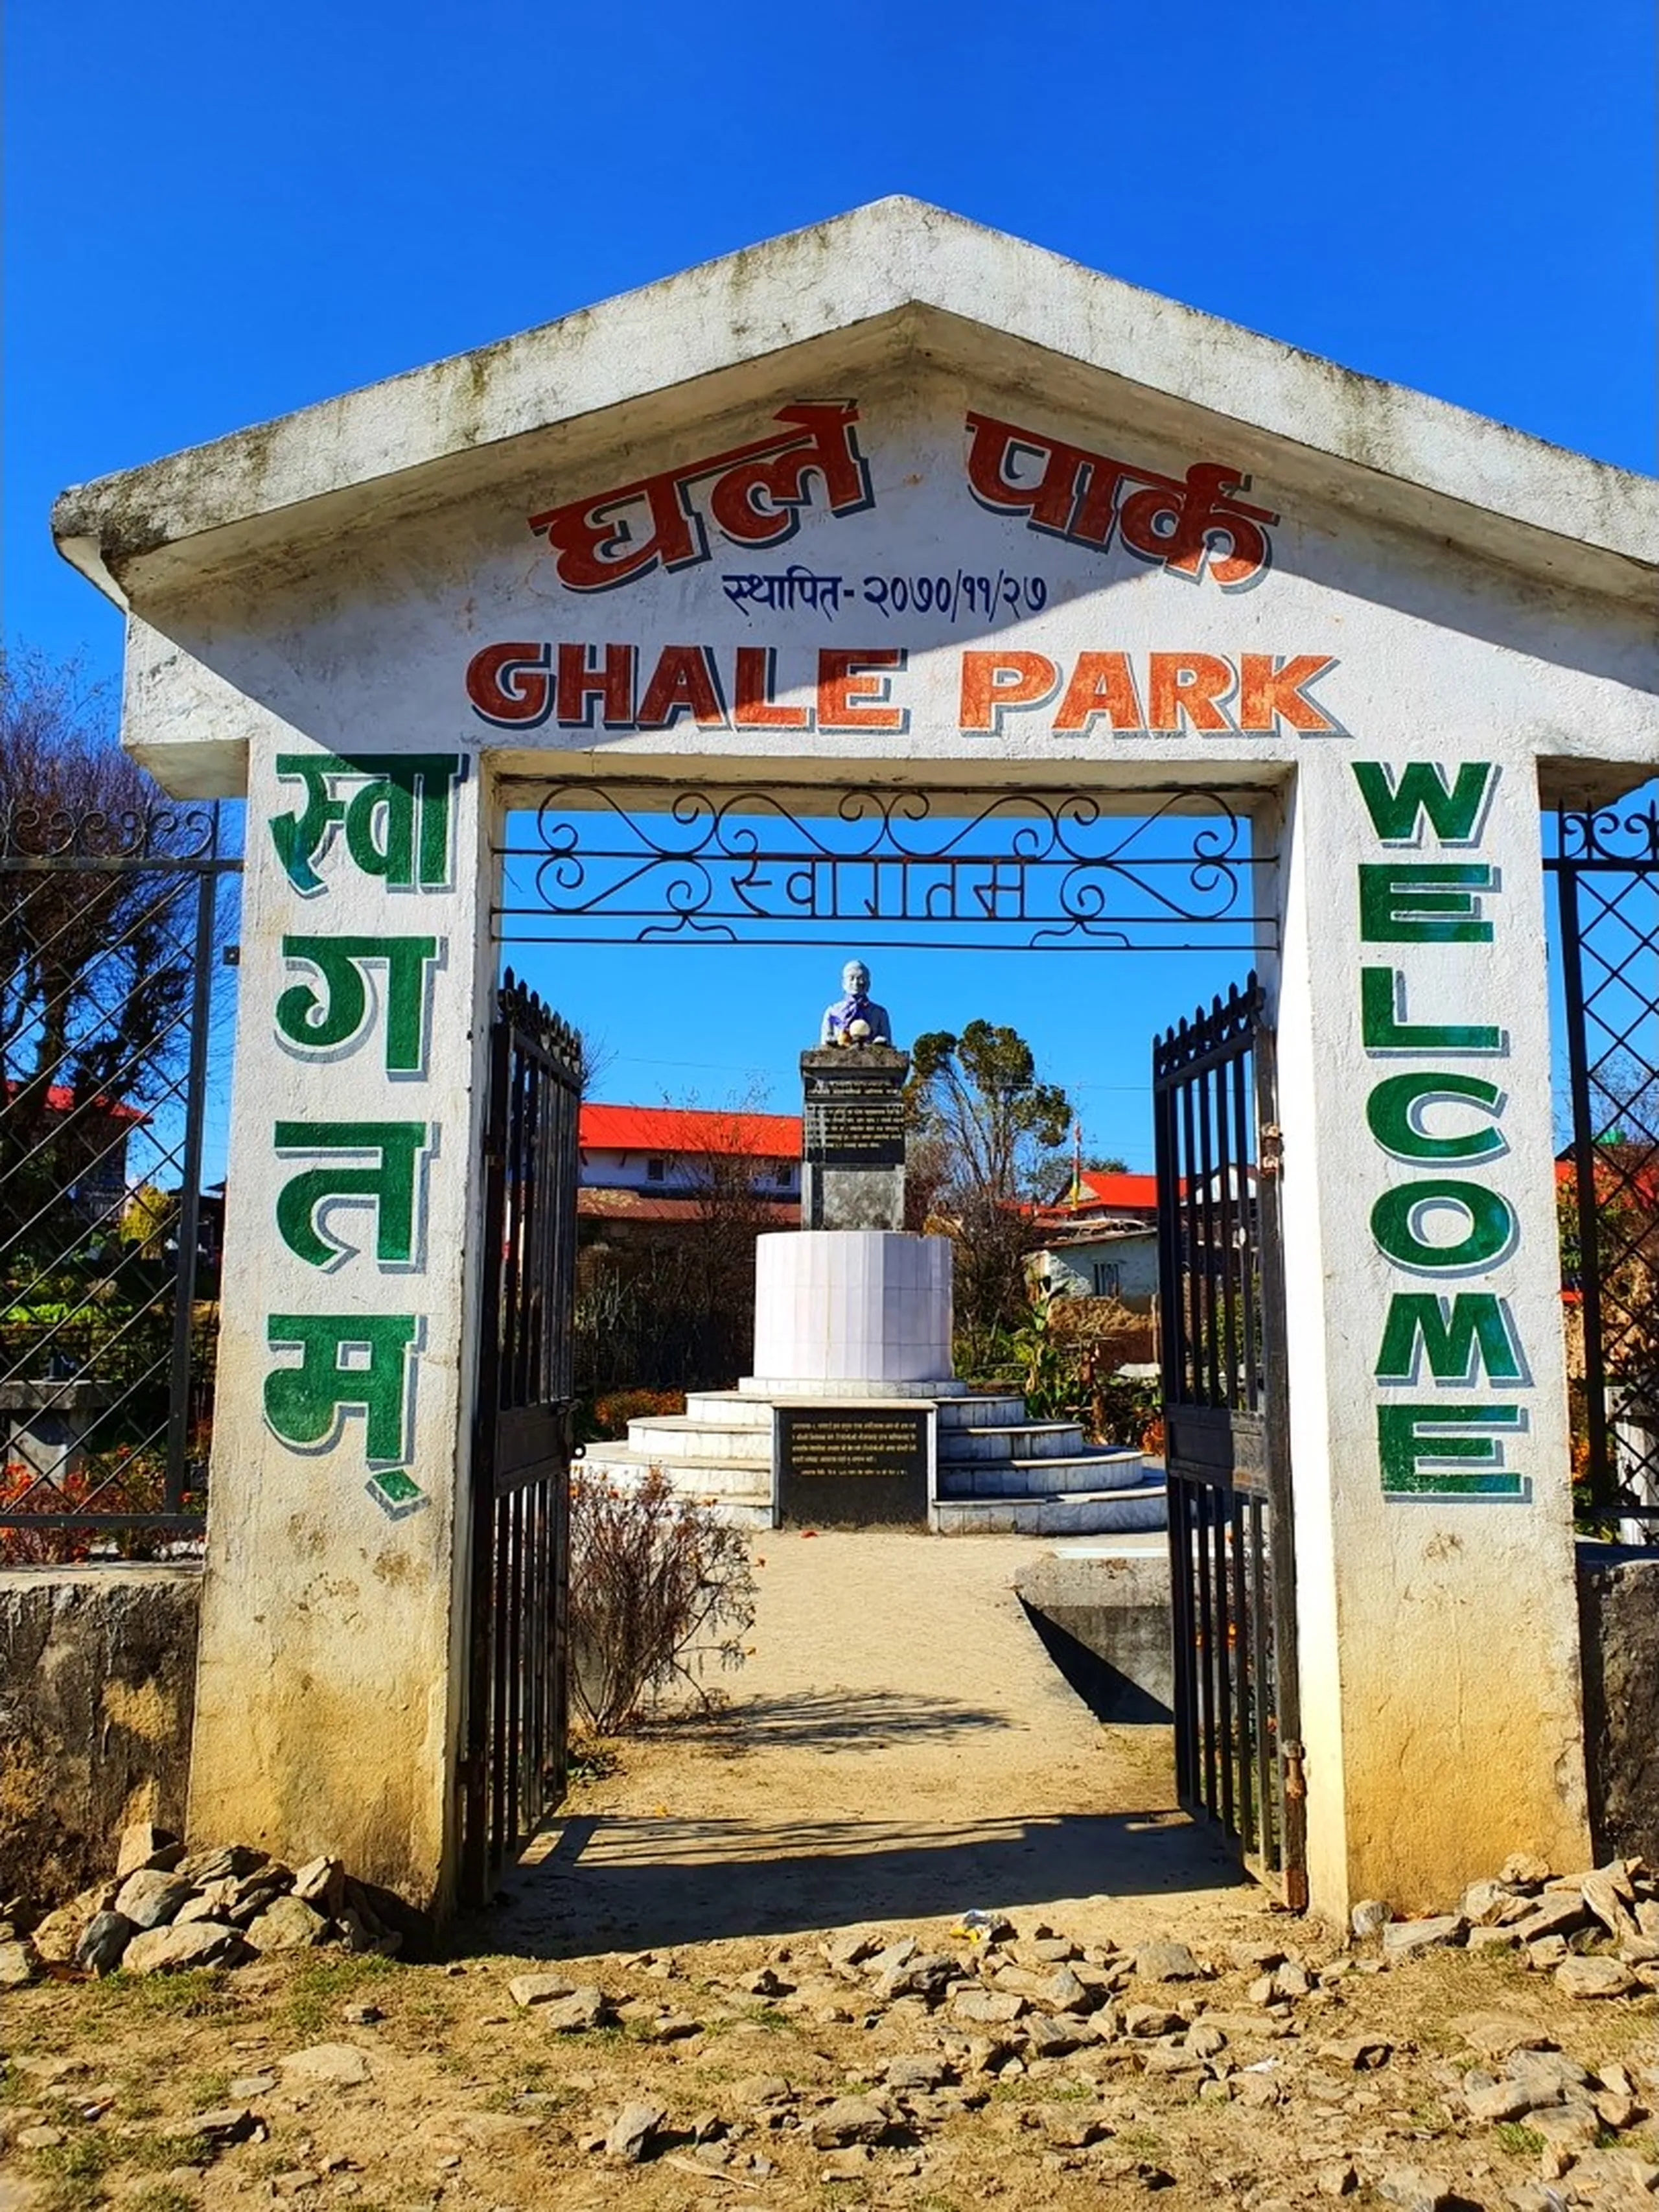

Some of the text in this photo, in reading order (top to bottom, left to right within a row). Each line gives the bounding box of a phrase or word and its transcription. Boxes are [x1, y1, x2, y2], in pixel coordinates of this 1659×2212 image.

[528, 399, 1281, 593] घले पार्क
[465, 642, 1354, 738] GHALE PARK
[1351, 762, 1534, 1504] WELCOME
